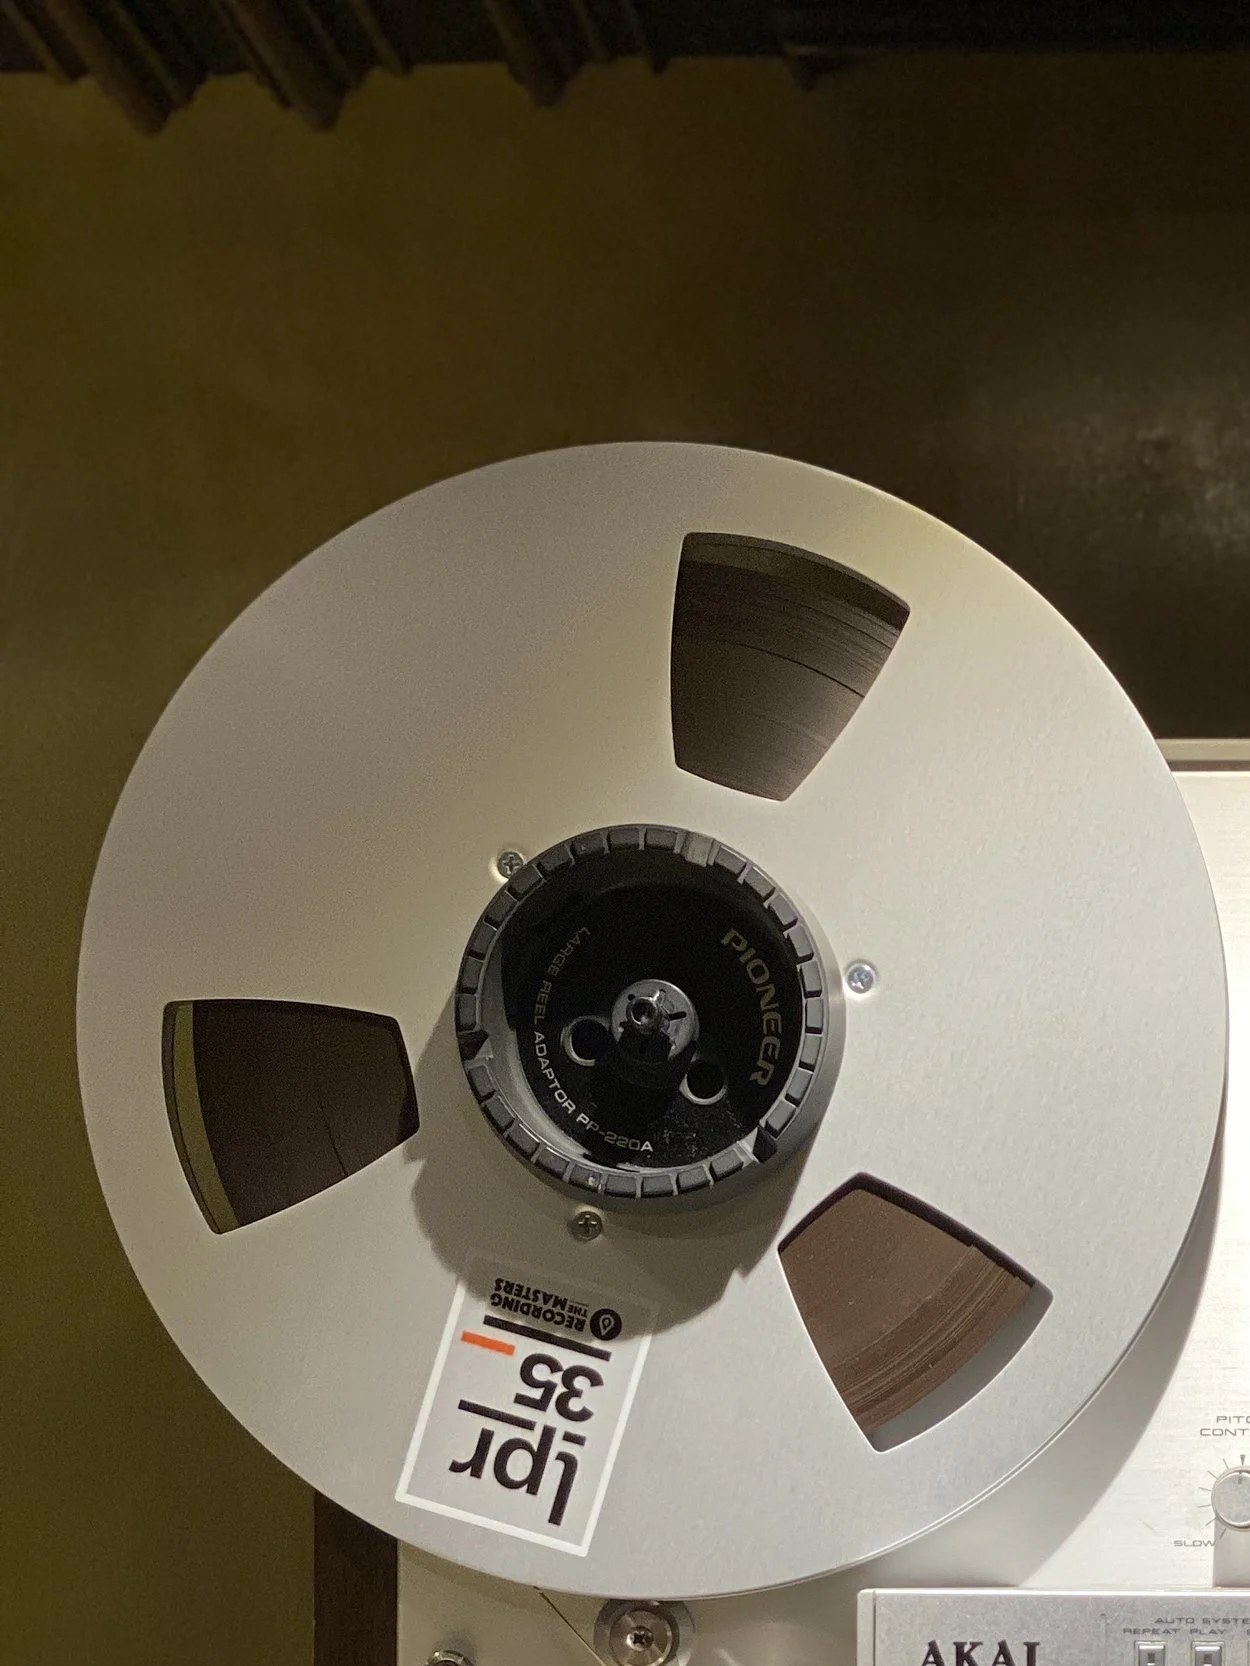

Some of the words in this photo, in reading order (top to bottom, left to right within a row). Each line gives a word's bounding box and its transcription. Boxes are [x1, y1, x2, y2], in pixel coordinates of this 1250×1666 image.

[550, 926, 591, 977] LARGE
[533, 979, 553, 1025] REEL
[722, 927, 783, 1087] PIONEER
[533, 1030, 577, 1115] ADAPTOR
[575, 1112, 654, 1152] PP-220A
[490, 1292, 586, 1332] RECORDING
[493, 1277, 568, 1311] MASTERS
[568, 1304, 588, 1318] THE
[513, 1353, 605, 1423] 35
[1154, 1617, 1195, 1625] AUTO
[1189, 1628, 1227, 1636] PLAY
